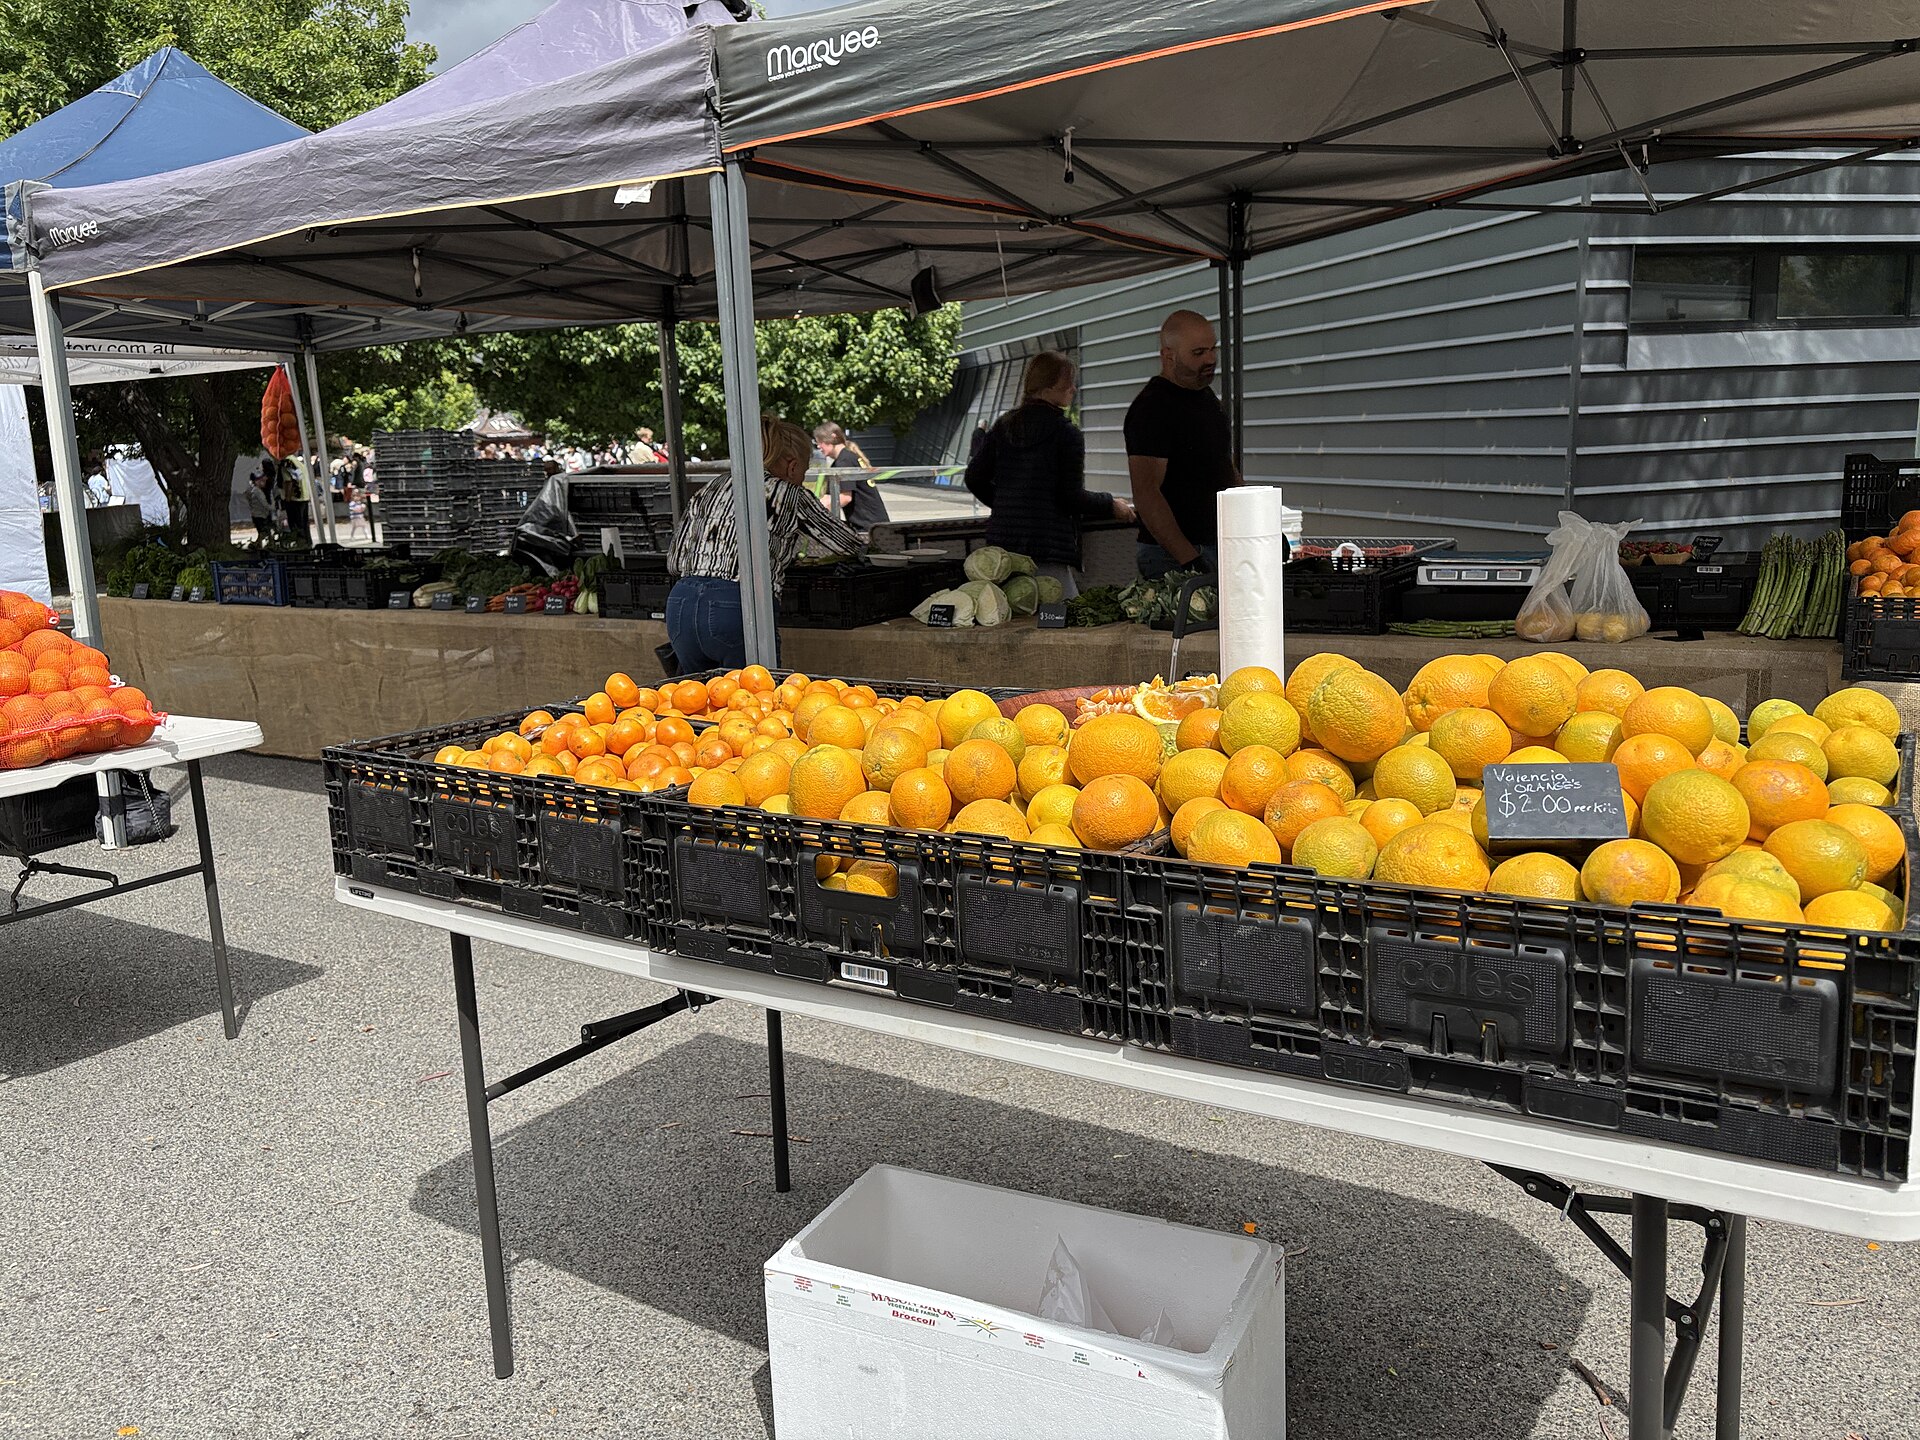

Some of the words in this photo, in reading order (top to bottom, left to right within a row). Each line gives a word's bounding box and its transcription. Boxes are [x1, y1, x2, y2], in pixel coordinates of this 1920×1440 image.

[1492, 766, 1568, 783] Valencia
[1398, 955, 1534, 1006] coles
[887, 1302, 919, 1313] VEGETABLE
[920, 1309, 940, 1318] FARMS
[891, 1309, 936, 1327] Broccoli
